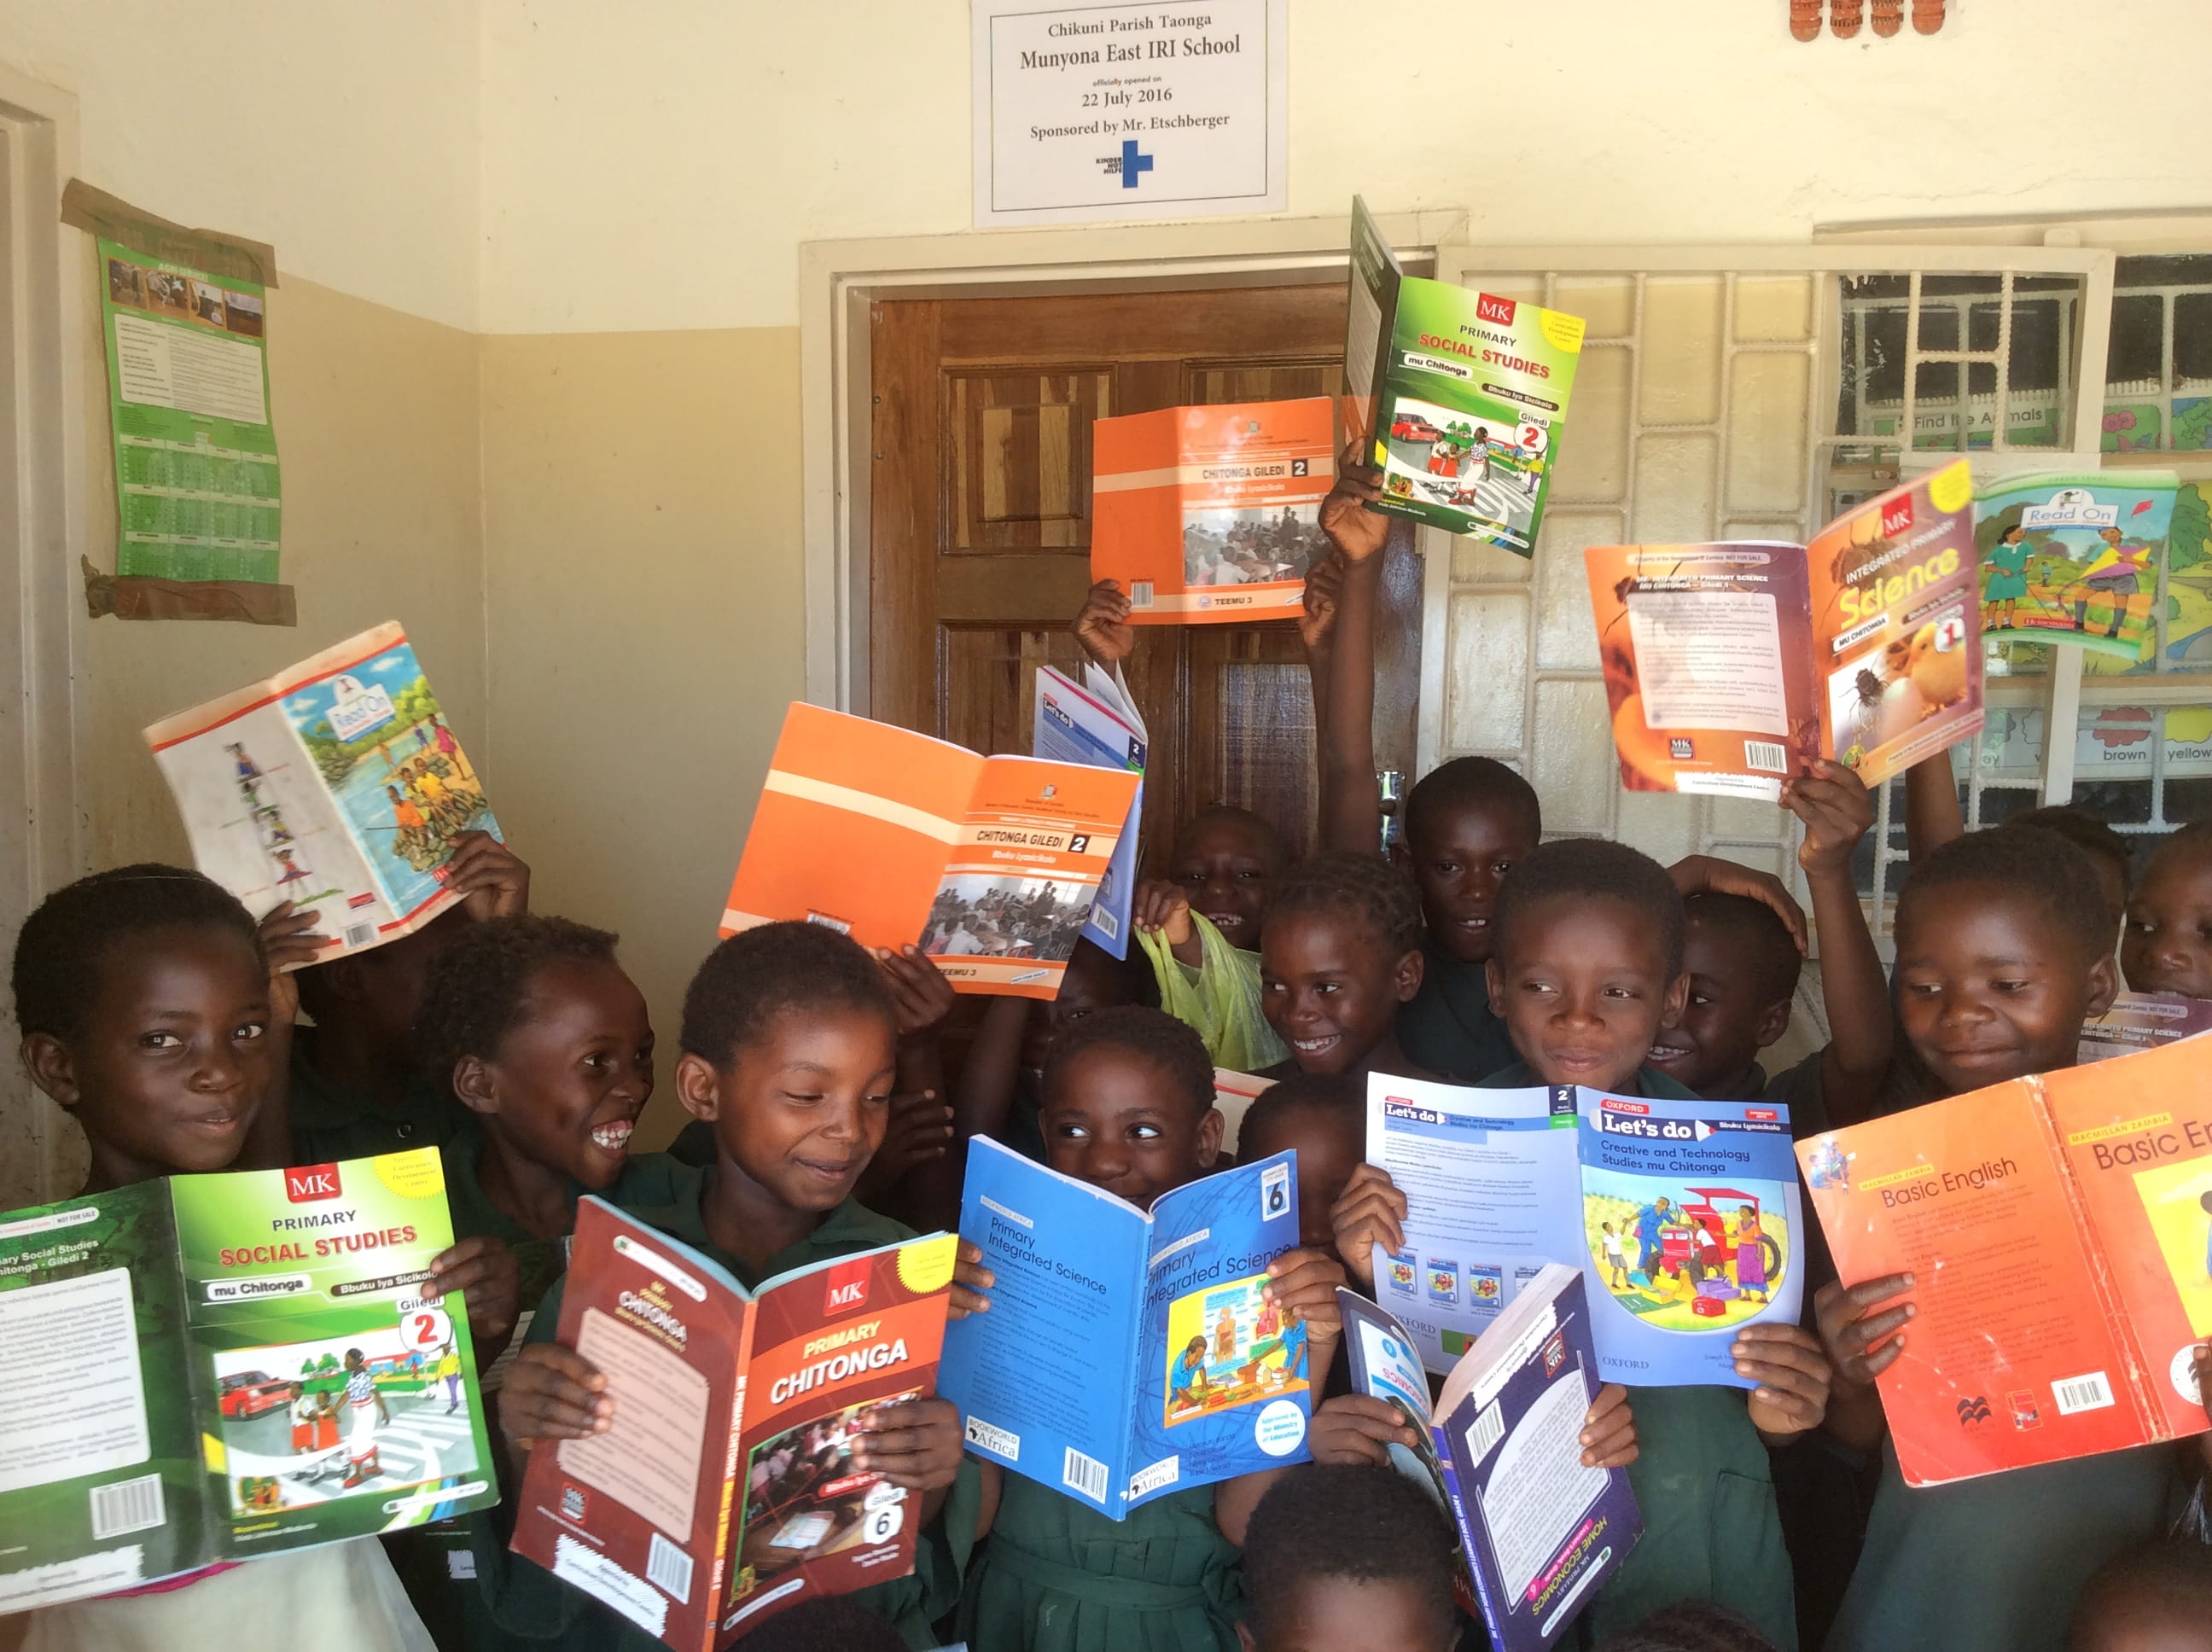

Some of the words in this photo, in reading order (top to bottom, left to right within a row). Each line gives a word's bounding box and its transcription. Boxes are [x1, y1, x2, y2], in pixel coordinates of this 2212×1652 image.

[1048, 21, 1104, 37] Chikuni
[1110, 18, 1154, 32] Parish
[1159, 15, 1212, 30] Taonga
[1021, 49, 1099, 72] Munyona
[1107, 44, 1142, 62] East
[1149, 40, 1176, 59] IRI
[1183, 34, 1241, 55] School
[1092, 78, 1122, 87] officially
[1124, 76, 1150, 85] opened
[1081, 94, 1099, 108] 22
[1104, 90, 1132, 108] July
[1138, 88, 1173, 102] 2016
[1030, 120, 1098, 141] Sponsored
[1103, 119, 1119, 135] by
[1122, 118, 1146, 131] Mr.
[1150, 113, 1230, 131] Etschberger
[1096, 156, 1122, 165] KINDER
[1480, 300, 1511, 322] MK
[1459, 324, 1517, 348] PRIMARY
[1408, 357, 1423, 366] mu
[1425, 359, 1468, 377] Chitonga
[1418, 334, 1477, 359] SOCIAL
[1481, 349, 1551, 380] STUDIES
[1521, 412, 1548, 427] Giledi
[1915, 415, 1946, 428] Find
[1981, 408, 2042, 425] Amals
[1522, 427, 1538, 448] 2
[1202, 467, 1252, 480] CHITONGA
[1254, 465, 1285, 477] GILEDI
[1294, 462, 1306, 475] 2
[1884, 509, 1912, 534] MK
[2030, 508, 2076, 521] Read
[2082, 507, 2111, 521] On
[1846, 544, 1911, 585] INTEGRATED
[1737, 574, 1769, 583] SCIENCE
[1839, 548, 1960, 631] Science
[1215, 596, 1245, 606] TEEMU
[1247, 596, 1253, 605] 3
[1838, 636, 1850, 647] MU
[1850, 617, 1887, 641] CHITONGA
[1942, 622, 1955, 647] 1
[1132, 743, 1140, 755] 2
[2104, 749, 2146, 761] brown
[2168, 748, 2212, 761] yellow
[976, 830, 1027, 845] CHITONGA
[1029, 835, 1065, 848] GILEDI
[1072, 836, 1087, 852] 2
[969, 969, 977, 977] 3
[2122, 1026, 2154, 1035] PRIMARY
[2155, 1029, 2183, 1038] SCIENCE
[1557, 1090, 1569, 1101] 2
[1605, 1100, 1644, 1114] OXFORD
[1385, 1104, 1417, 1120] Let's
[1418, 1112, 1435, 1123] do
[1604, 1114, 1659, 1137] Let's
[1662, 1121, 1692, 1139] do
[2071, 1124, 2128, 1143] MACMILLAN
[2131, 1114, 2169, 1131] ZAMBIA
[1600, 1140, 1650, 1157] Creative
[1654, 1145, 1676, 1158] and
[1680, 1148, 1750, 1163] Technology
[2092, 1131, 2180, 1171] Basic
[1602, 1154, 1644, 1170] Studies
[1647, 1161, 1665, 1171] mu
[1669, 1160, 1726, 1175] Chitonga
[290, 1172, 338, 1197] MK
[1861, 1173, 1903, 1190] MACMILLAN
[1905, 1166, 1932, 1178] ZAMBIA
[1881, 1180, 1940, 1208] Basic
[1941, 1157, 2018, 1193] English
[1269, 1183, 1284, 1212] 6
[81, 1210, 96, 1219] SALE
[271, 1209, 357, 1232] PRIMARY
[991, 1216, 1036, 1250] Primary
[21, 1247, 56, 1260] Social
[58, 1240, 99, 1254] Studies
[219, 1240, 308, 1268] SOCIAL
[313, 1225, 418, 1257] STUDIES
[47, 1254, 79, 1267] Giledi
[81, 1251, 89, 1260] 2
[988, 1231, 1052, 1271] Integrated
[1056, 1262, 1107, 1295] Science
[214, 1288, 236, 1297] mu
[240, 1279, 304, 1295] Chitonga
[341, 1282, 375, 1294] Bbuku
[829, 1280, 864, 1307] MK
[1147, 1261, 1220, 1311] ntegrated
[414, 1314, 439, 1345] 2
[802, 1320, 882, 1360] PRIMARY
[769, 1338, 909, 1405] CHITONGA
[1602, 1356, 1650, 1370] OXFORD
[730, 1391, 745, 1432] PRIMARY
[968, 1417, 1017, 1445] BOOKWORLD
[725, 1433, 741, 1480] CHITONGA
[977, 1433, 1016, 1458] Africa
[1132, 1458, 1177, 1486] BOOKWORLD
[1138, 1470, 1176, 1494] Africa
[876, 1511, 891, 1536] 6
[1582, 1515, 1609, 1553] HOME
[1580, 1552, 1591, 1567] MK
[1529, 1583, 1537, 1597] 6
[1532, 1548, 1583, 1616] ECONOMICS
[1557, 1565, 1580, 1599] PRIMARY
